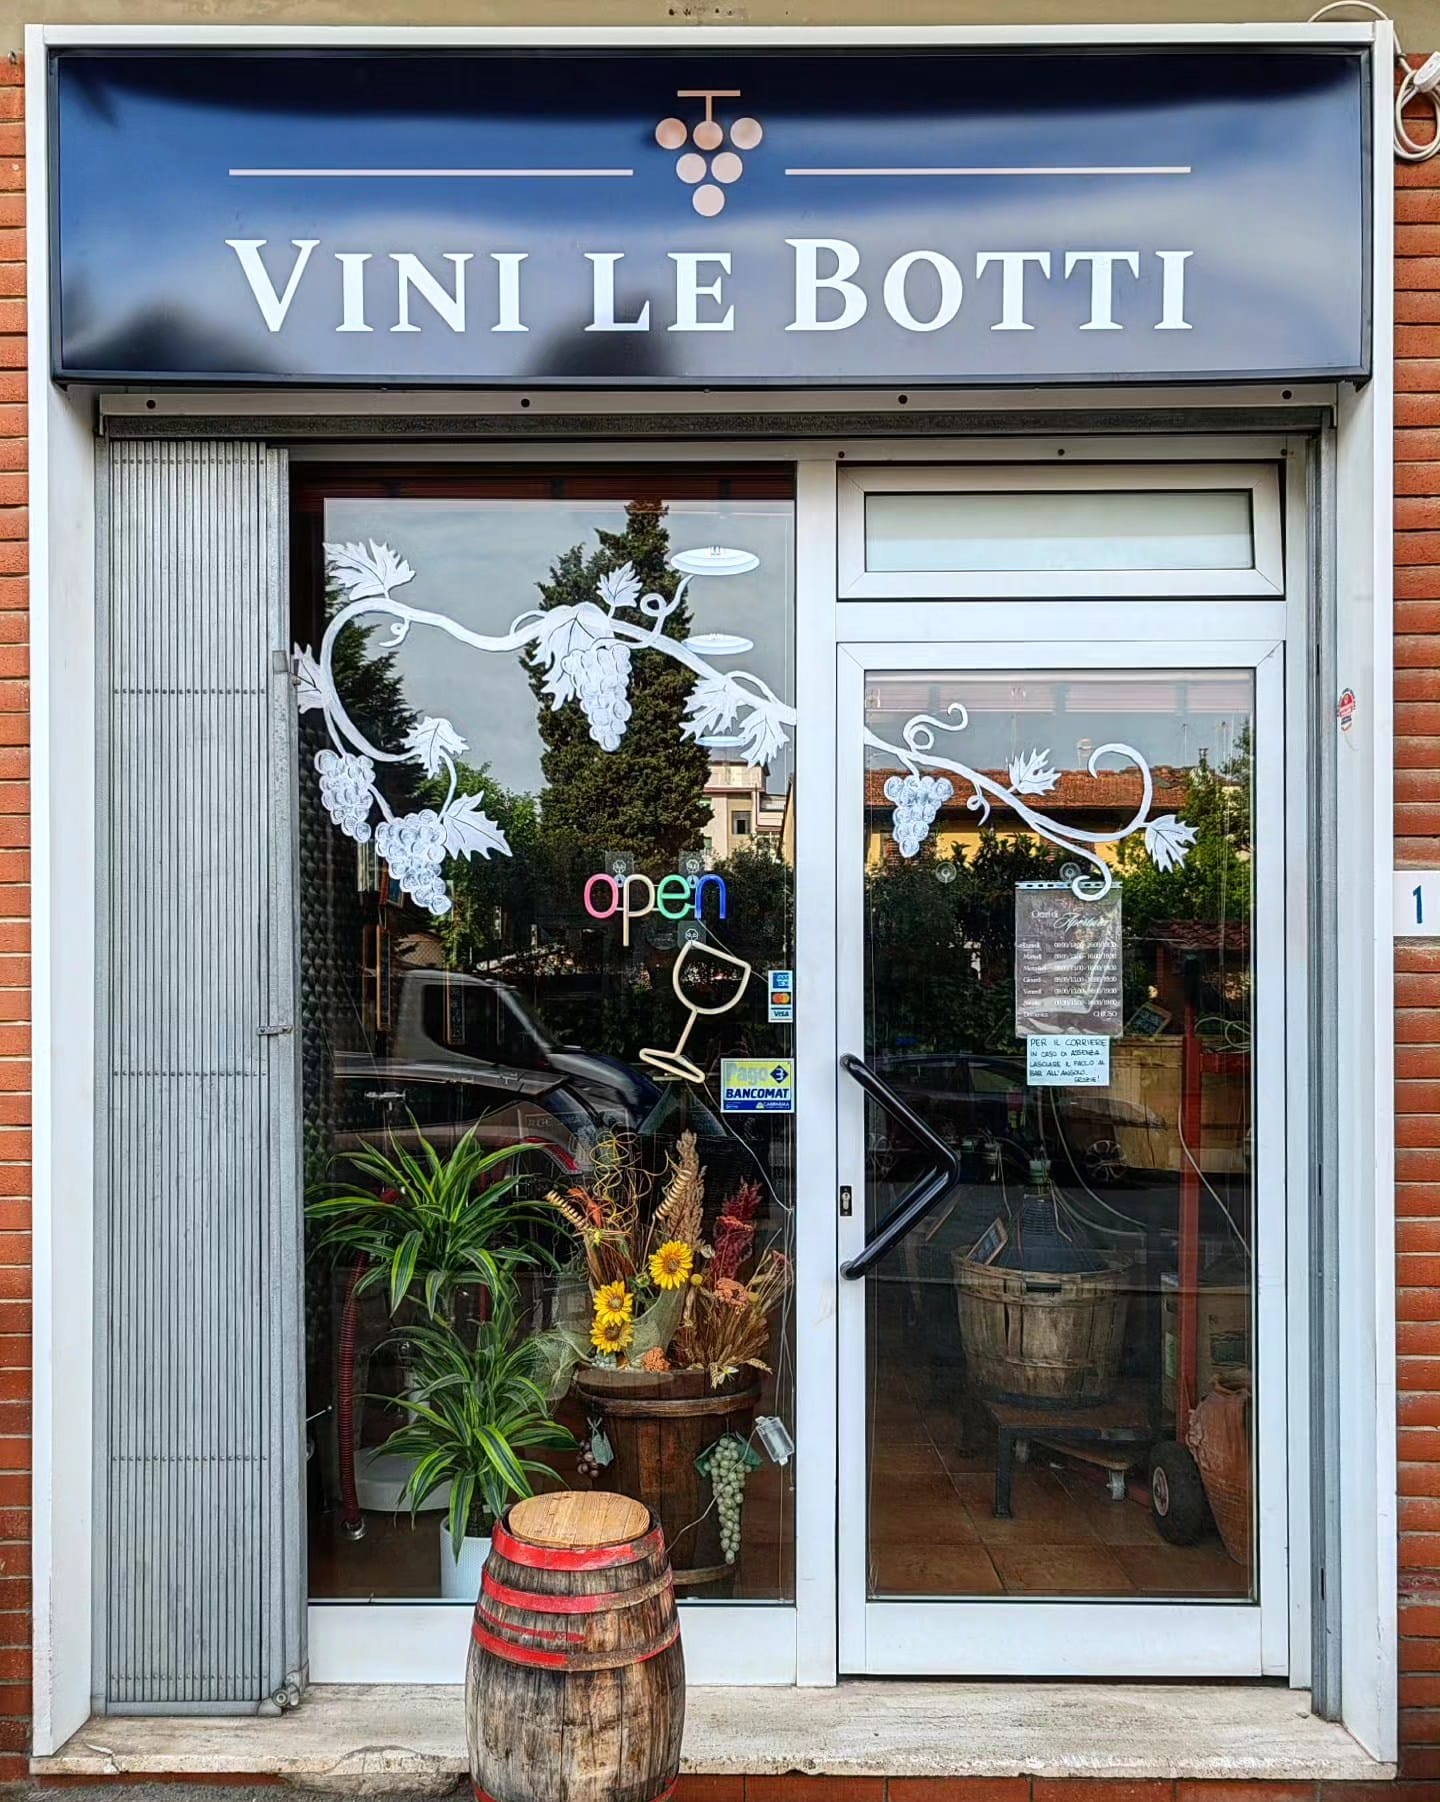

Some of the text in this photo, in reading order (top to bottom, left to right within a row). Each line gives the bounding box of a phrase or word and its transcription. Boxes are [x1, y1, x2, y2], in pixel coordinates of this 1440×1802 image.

[225, 238, 1194, 334] VINI LE BOTTI
[584, 873, 727, 947] open
[1412, 884, 1423, 924] 1
[1030, 1038, 1047, 1047] PER
[1064, 1038, 1107, 1047] CORRIERE
[725, 1063, 768, 1086] Pago
[725, 1088, 790, 1100] BANCOMAT
